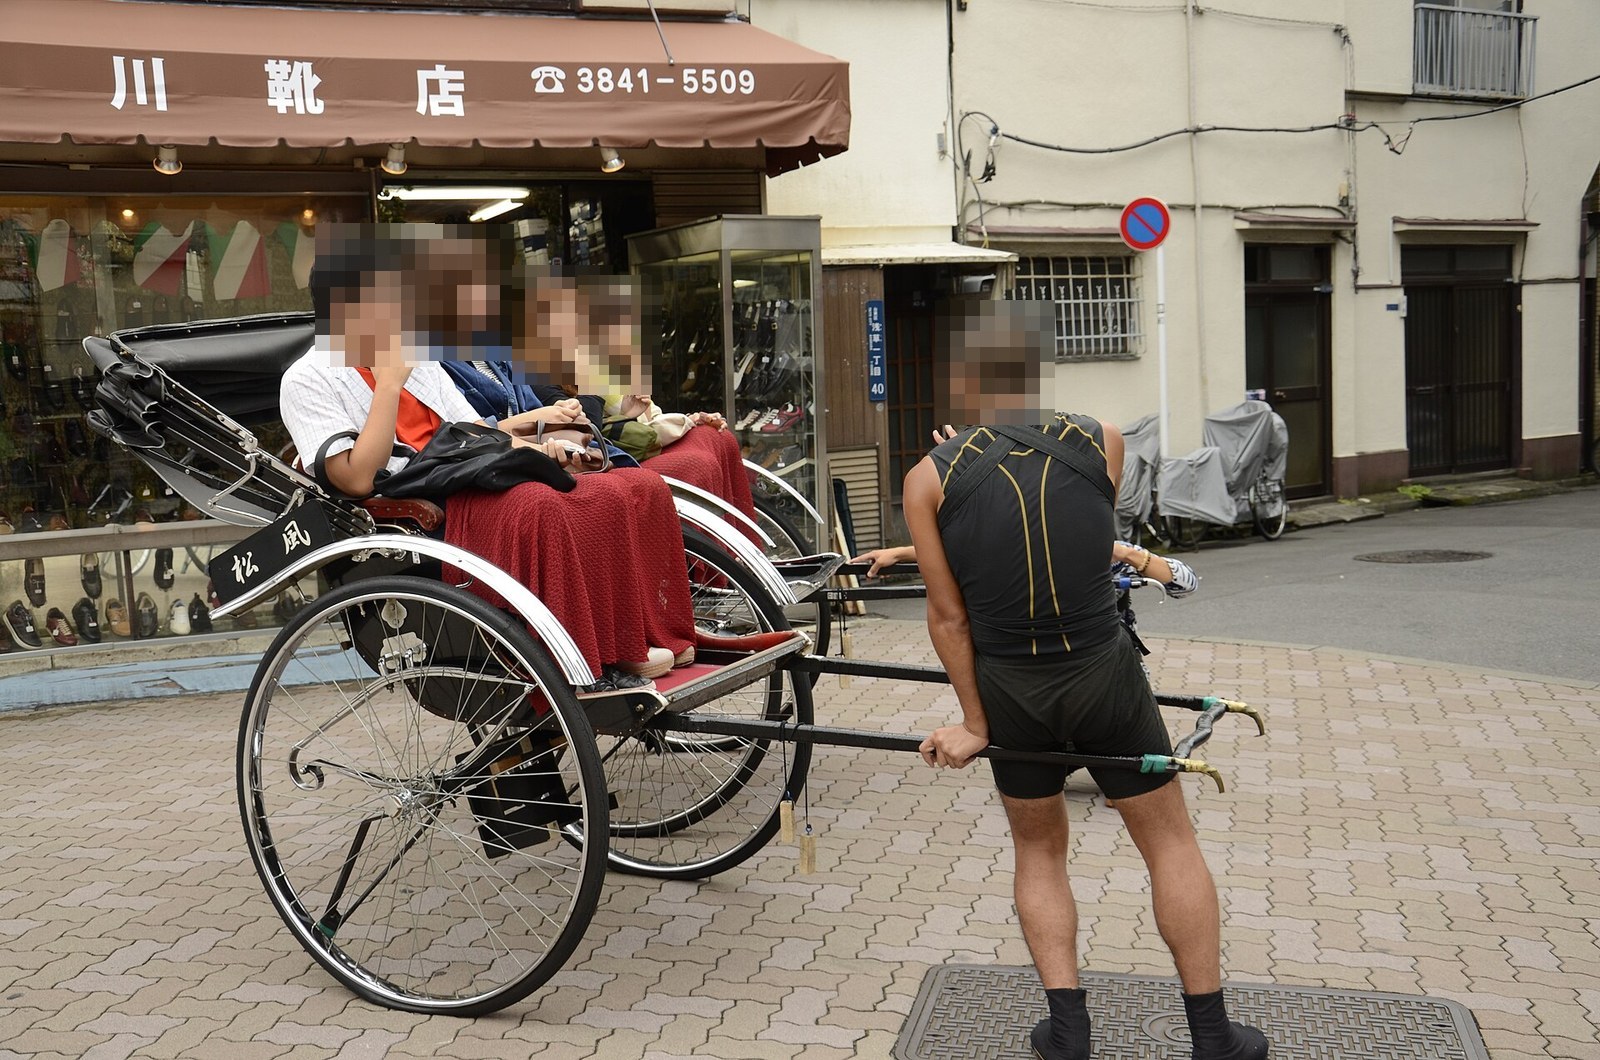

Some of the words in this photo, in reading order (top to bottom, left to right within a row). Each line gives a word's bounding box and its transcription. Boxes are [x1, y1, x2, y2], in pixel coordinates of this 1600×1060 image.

[110, 55, 466, 117] 川靴店
[576, 67, 757, 96] 3841-5509
[871, 383, 885, 395] 40
